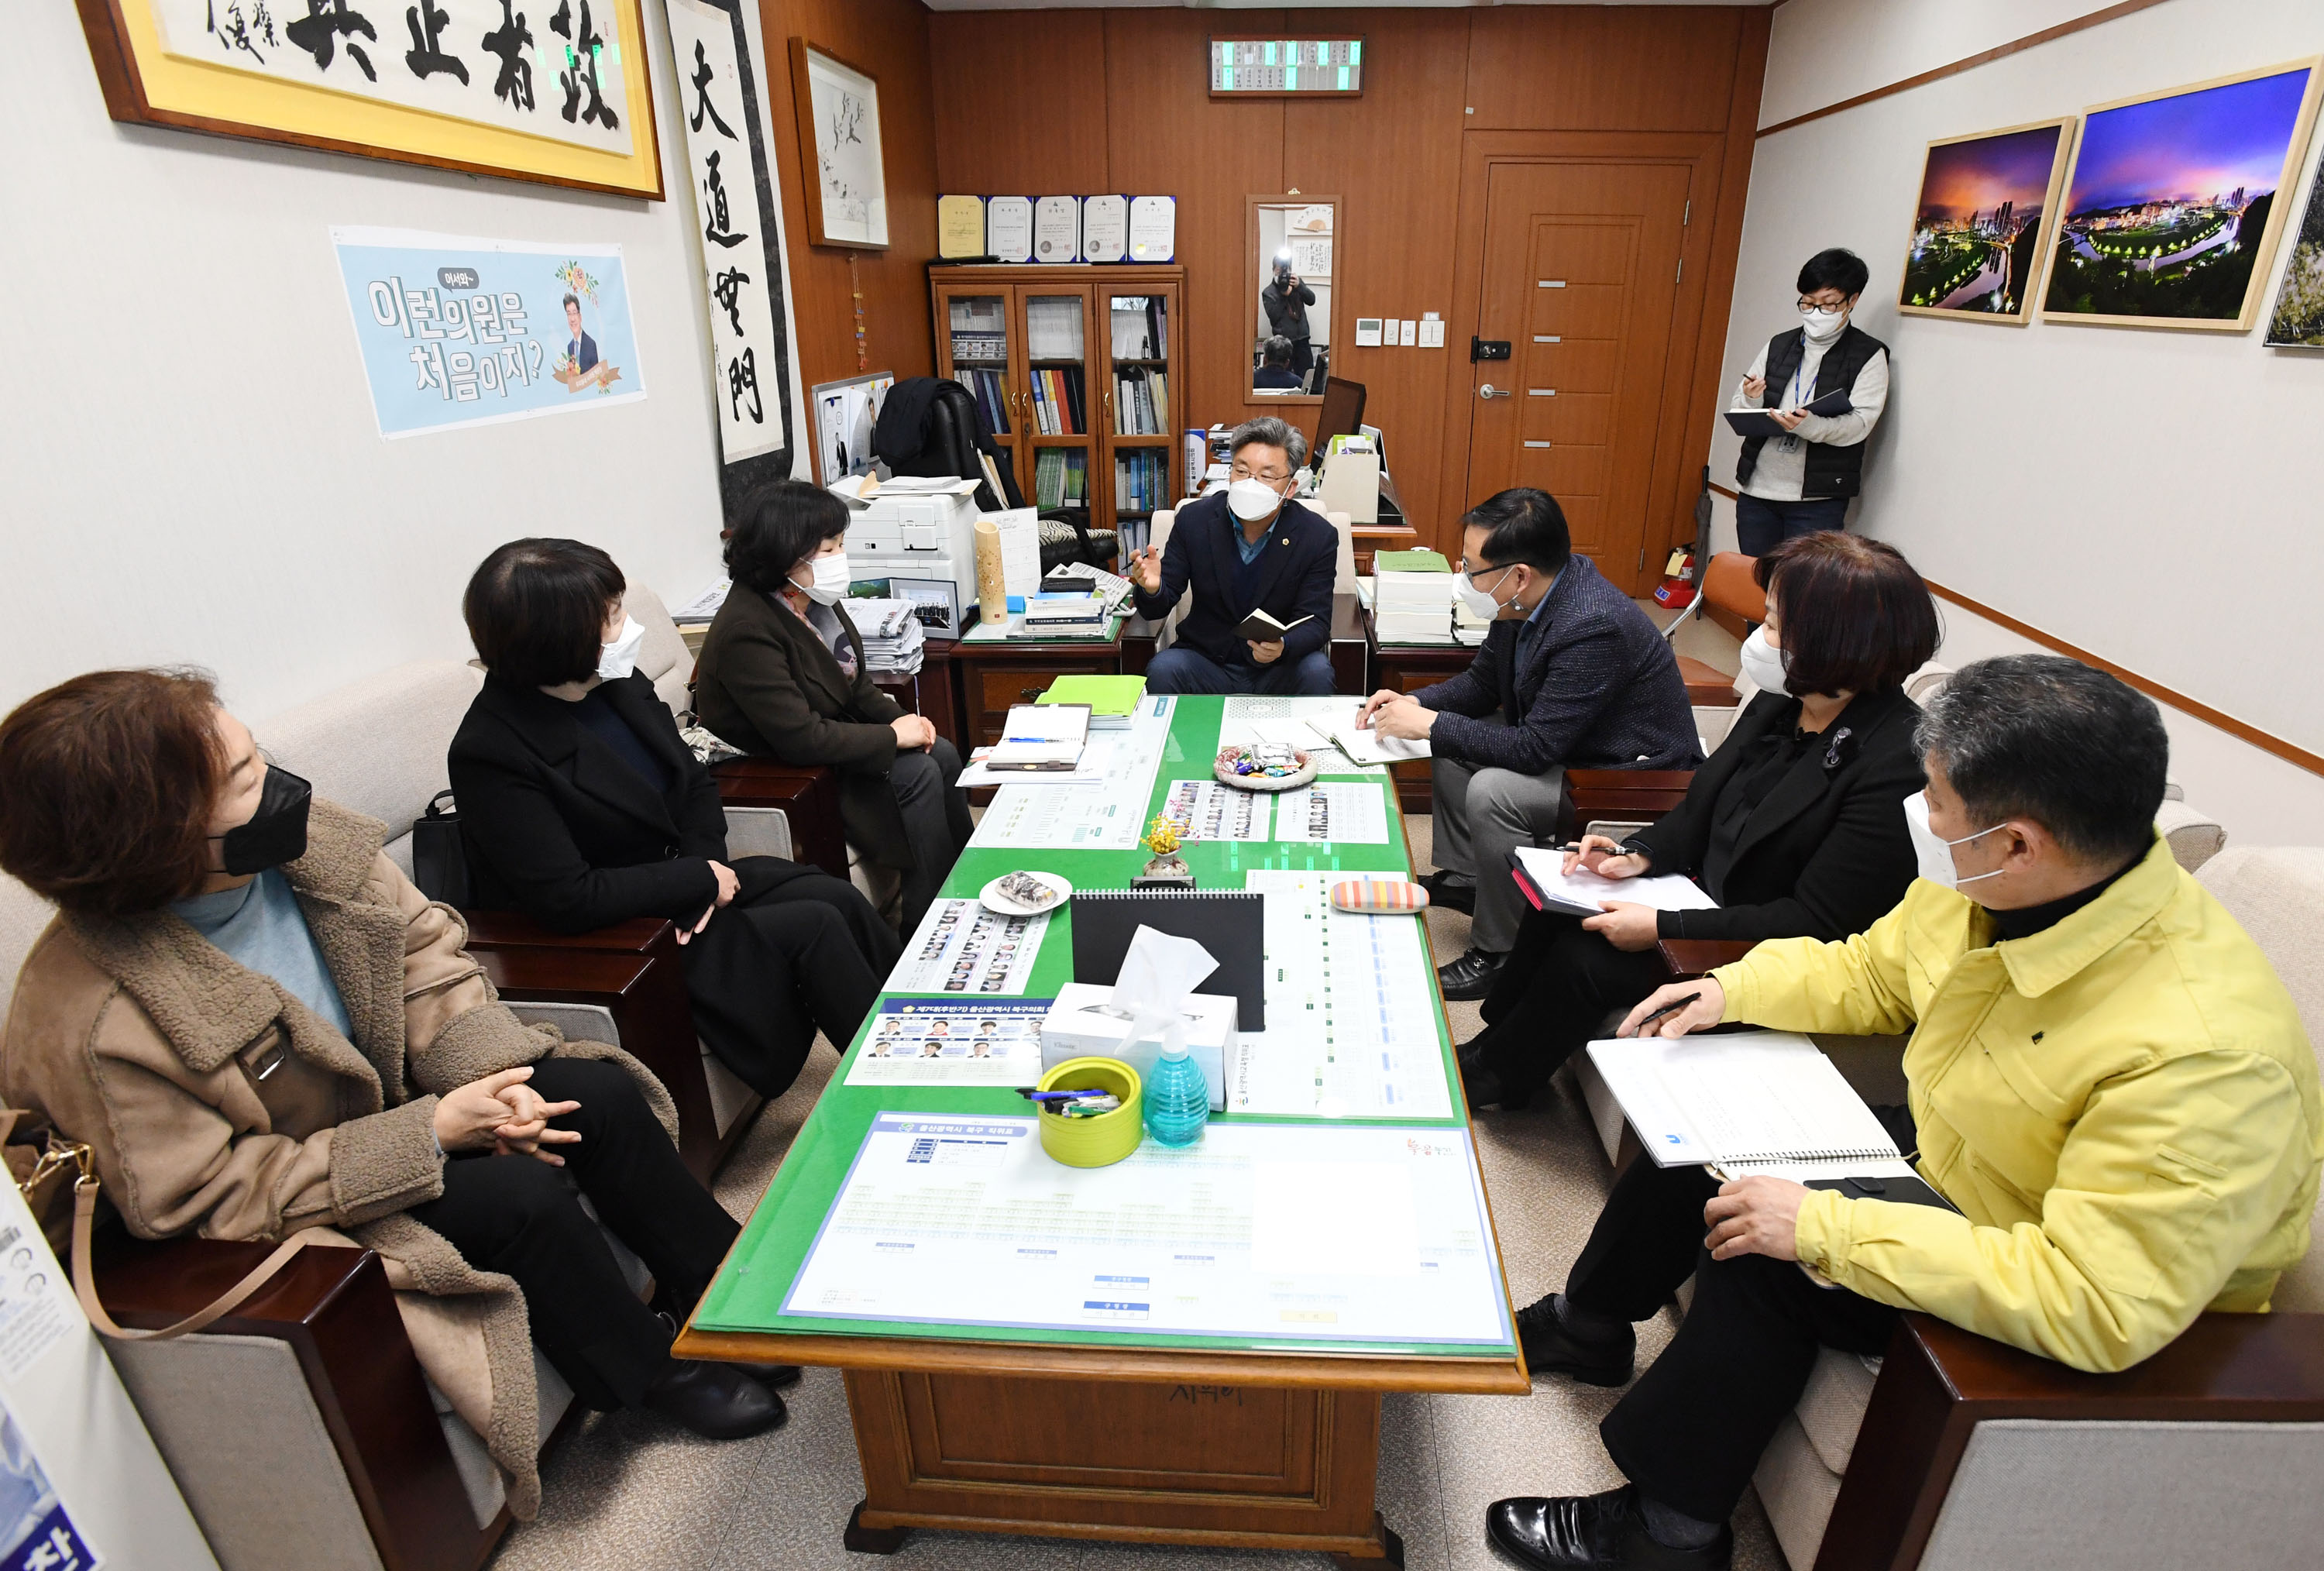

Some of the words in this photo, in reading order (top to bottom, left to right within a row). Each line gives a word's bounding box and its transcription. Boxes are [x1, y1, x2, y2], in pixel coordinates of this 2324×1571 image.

[444, 272, 474, 287] 어서와~
[409, 339, 544, 402] 처음이지?
[919, 1125, 962, 1133] 울산광역시
